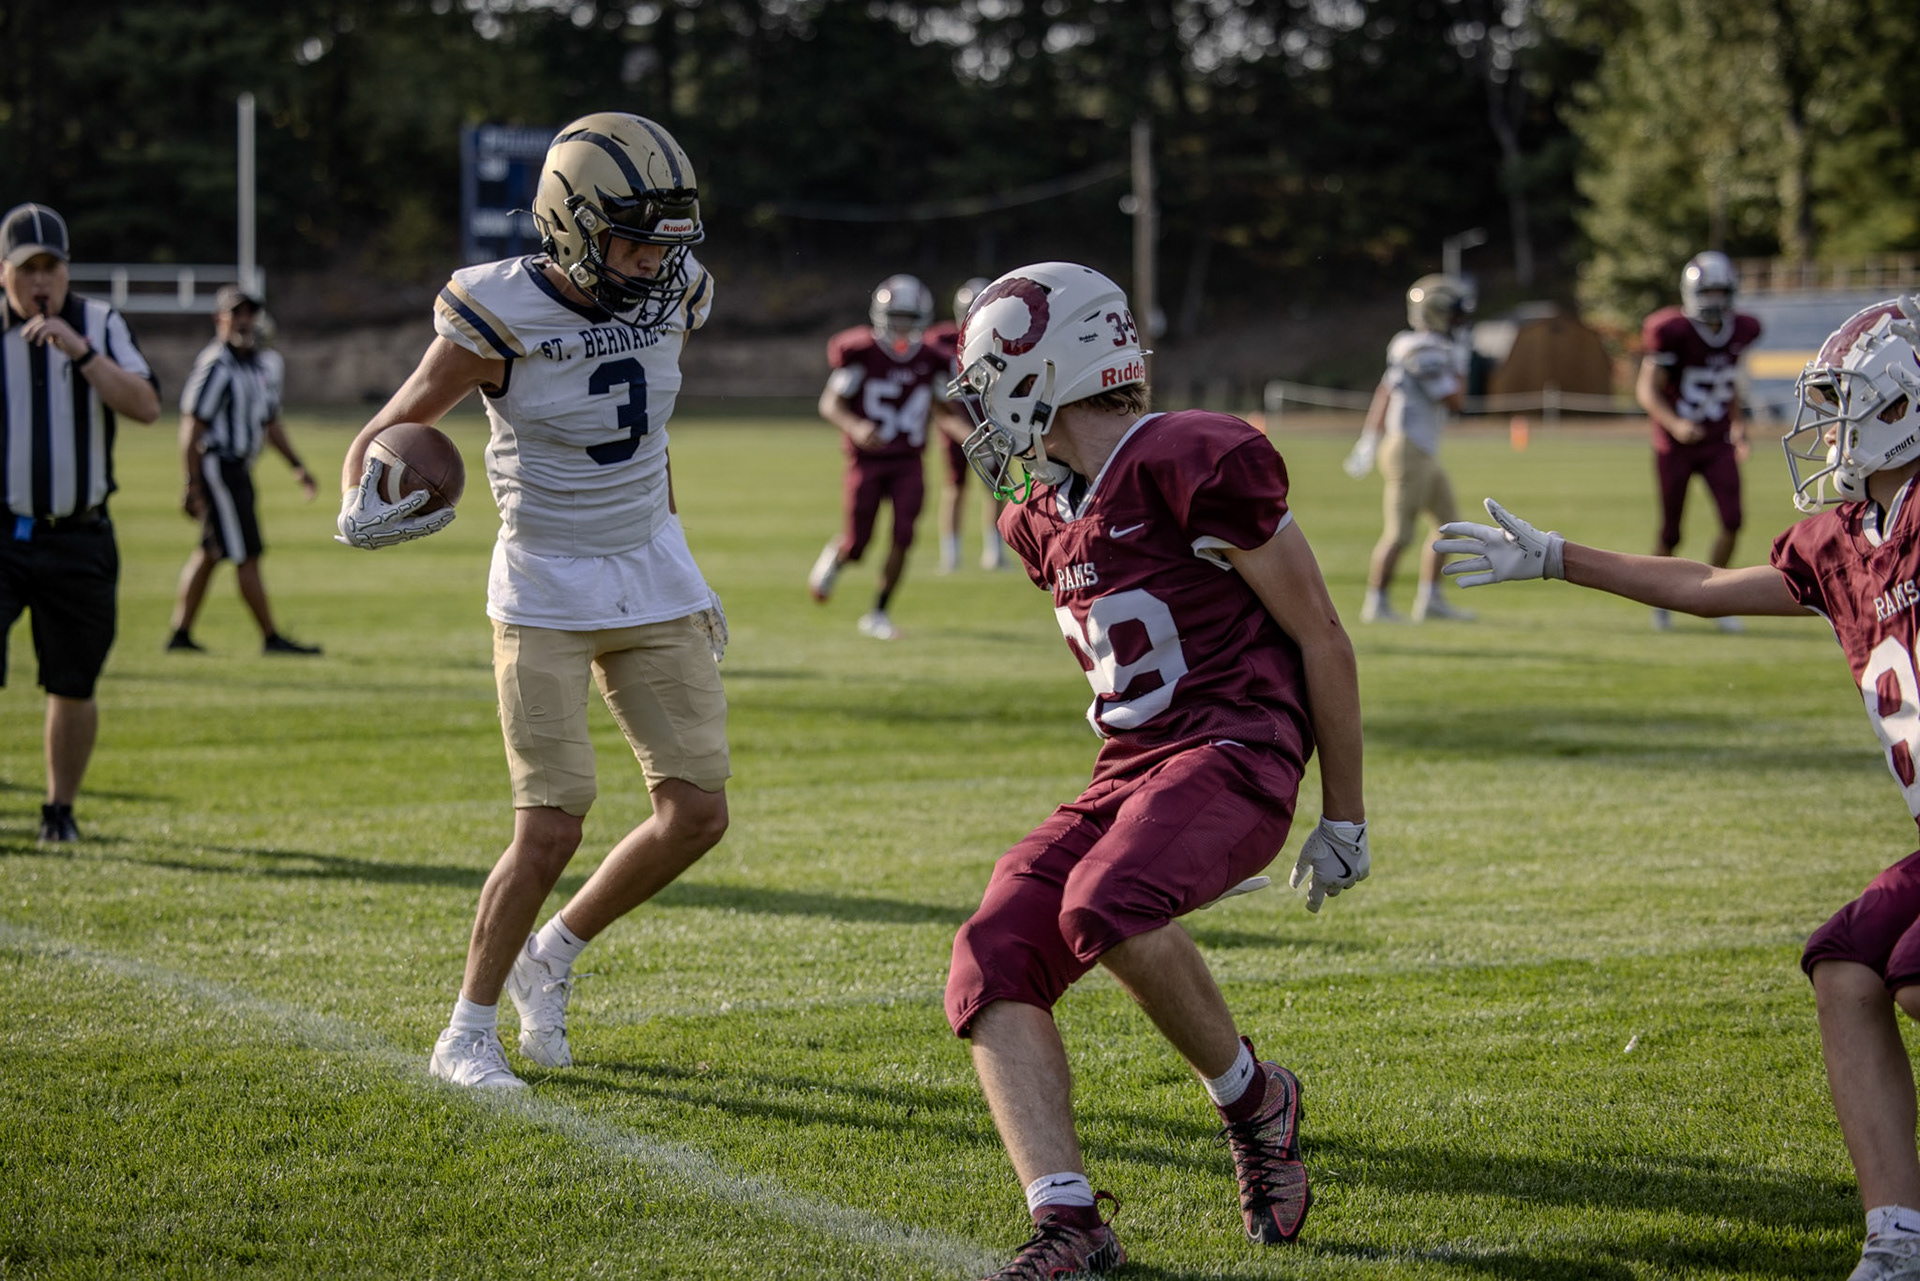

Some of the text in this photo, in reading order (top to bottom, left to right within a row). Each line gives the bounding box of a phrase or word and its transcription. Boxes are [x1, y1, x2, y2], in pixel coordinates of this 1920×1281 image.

[540, 322, 673, 362] ST. BERNAR
[1105, 309, 1138, 347] 39
[1101, 360, 1145, 388] Ridde
[585, 357, 648, 466] 3
[863, 377, 932, 447] 54
[1056, 562, 1099, 591] RAMS
[1873, 579, 1920, 621] RAMS
[1861, 635, 1920, 818] 8
